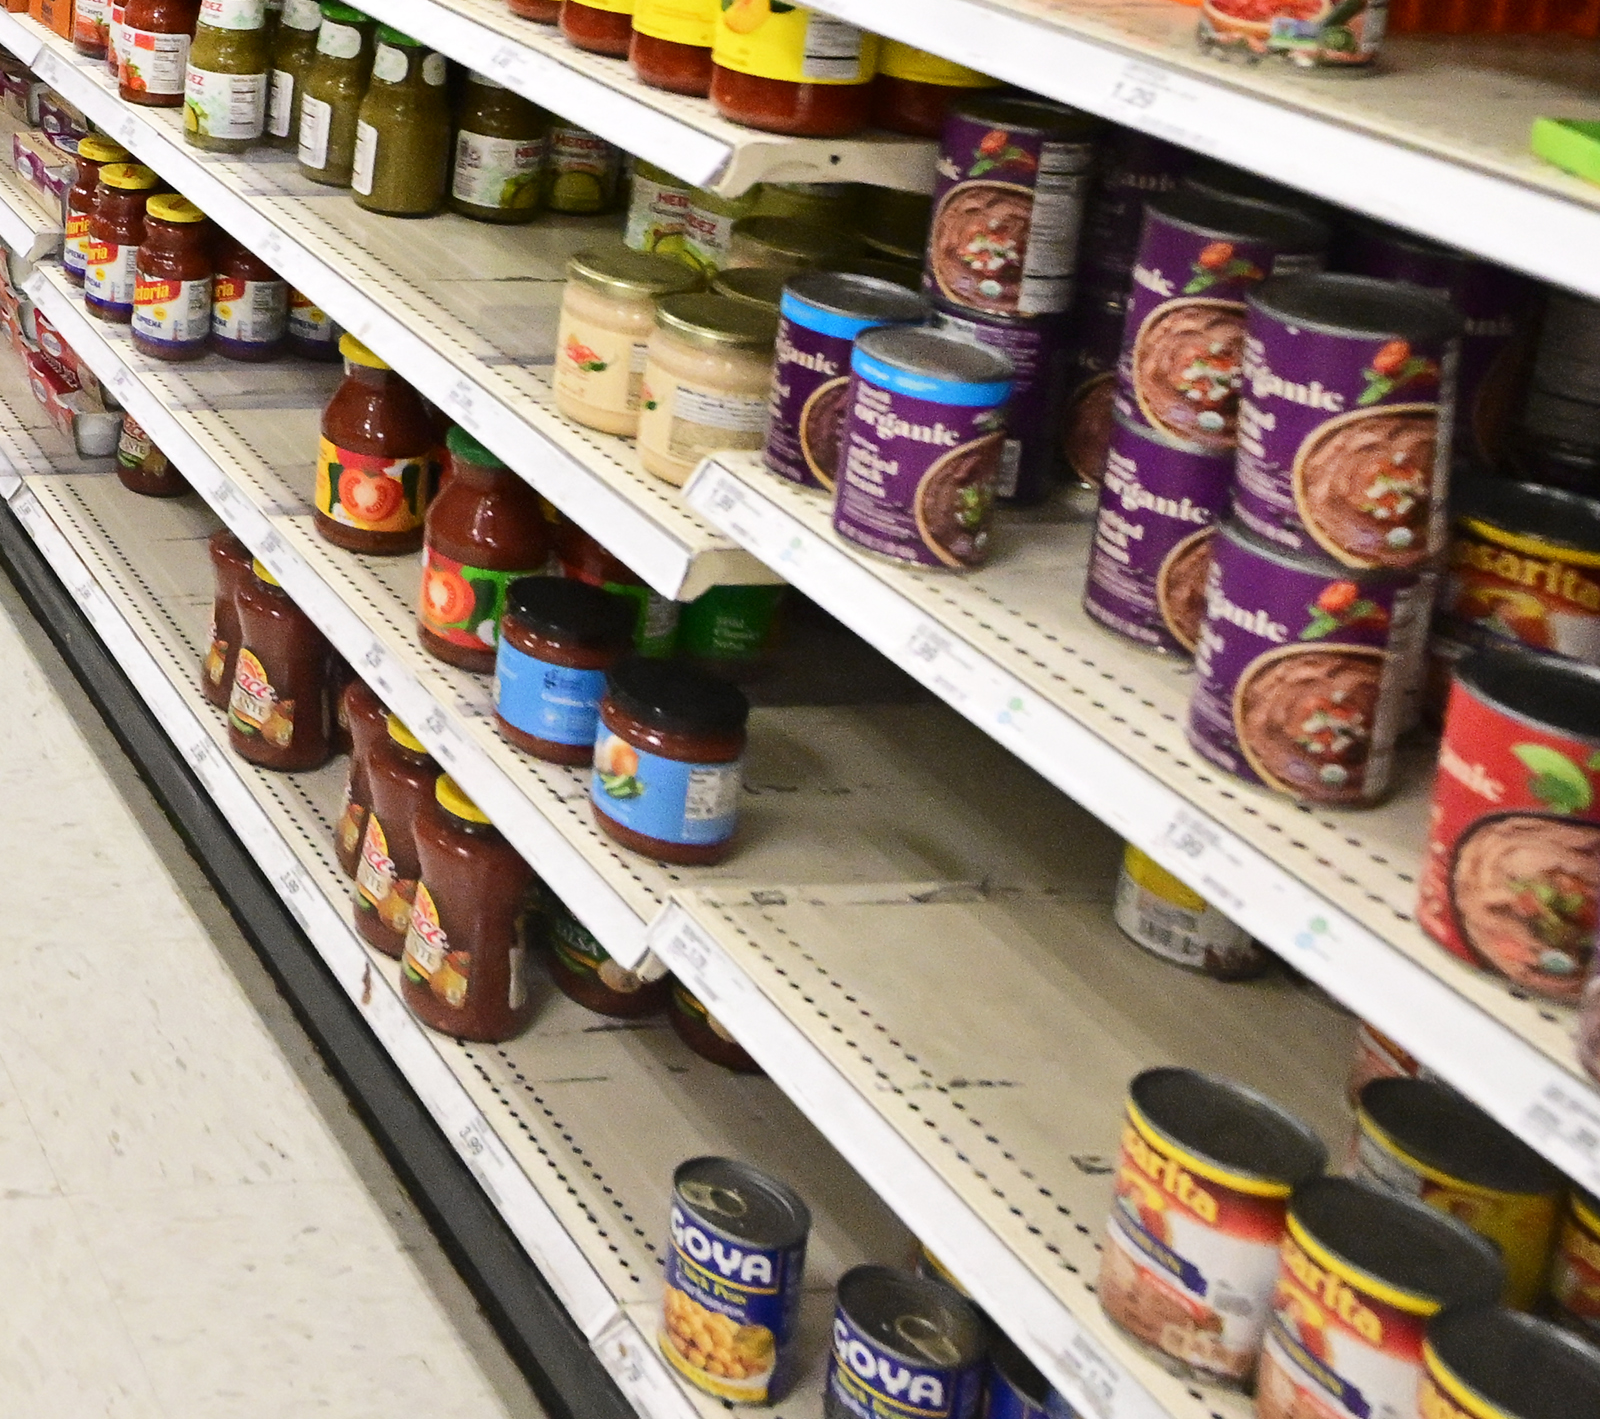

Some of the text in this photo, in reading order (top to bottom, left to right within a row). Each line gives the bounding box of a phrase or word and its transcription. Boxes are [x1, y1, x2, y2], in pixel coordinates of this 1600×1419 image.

[235, 672, 276, 701] ace
[458, 1125, 485, 1157] 3.99
[670, 1207, 773, 1286] GOYA
[832, 1317, 946, 1408] GOYA
